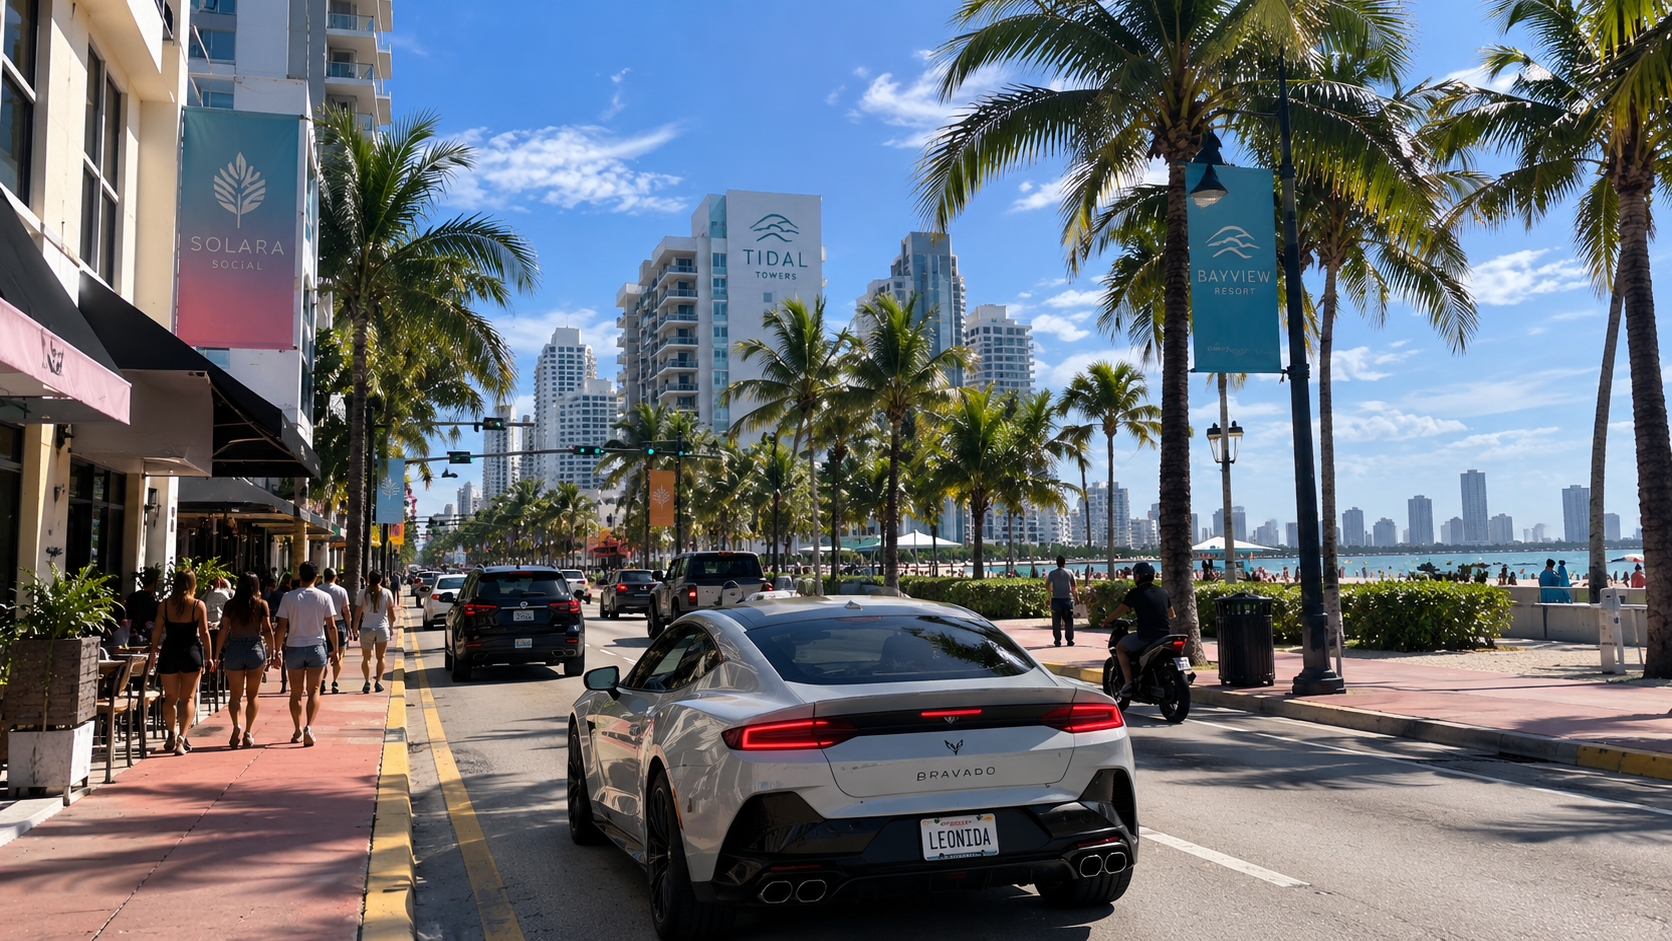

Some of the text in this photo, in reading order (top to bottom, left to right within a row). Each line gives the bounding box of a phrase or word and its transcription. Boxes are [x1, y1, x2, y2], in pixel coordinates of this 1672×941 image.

[190, 235, 285, 256] SOLARA
[742, 248, 808, 268] TIDAL
[755, 271, 797, 281] TOWERS
[1197, 269, 1271, 283] BAYVIEW
[1214, 287, 1256, 295] RESORT
[916, 766, 996, 781] BRAVADO
[928, 827, 992, 850] LEONIDA
